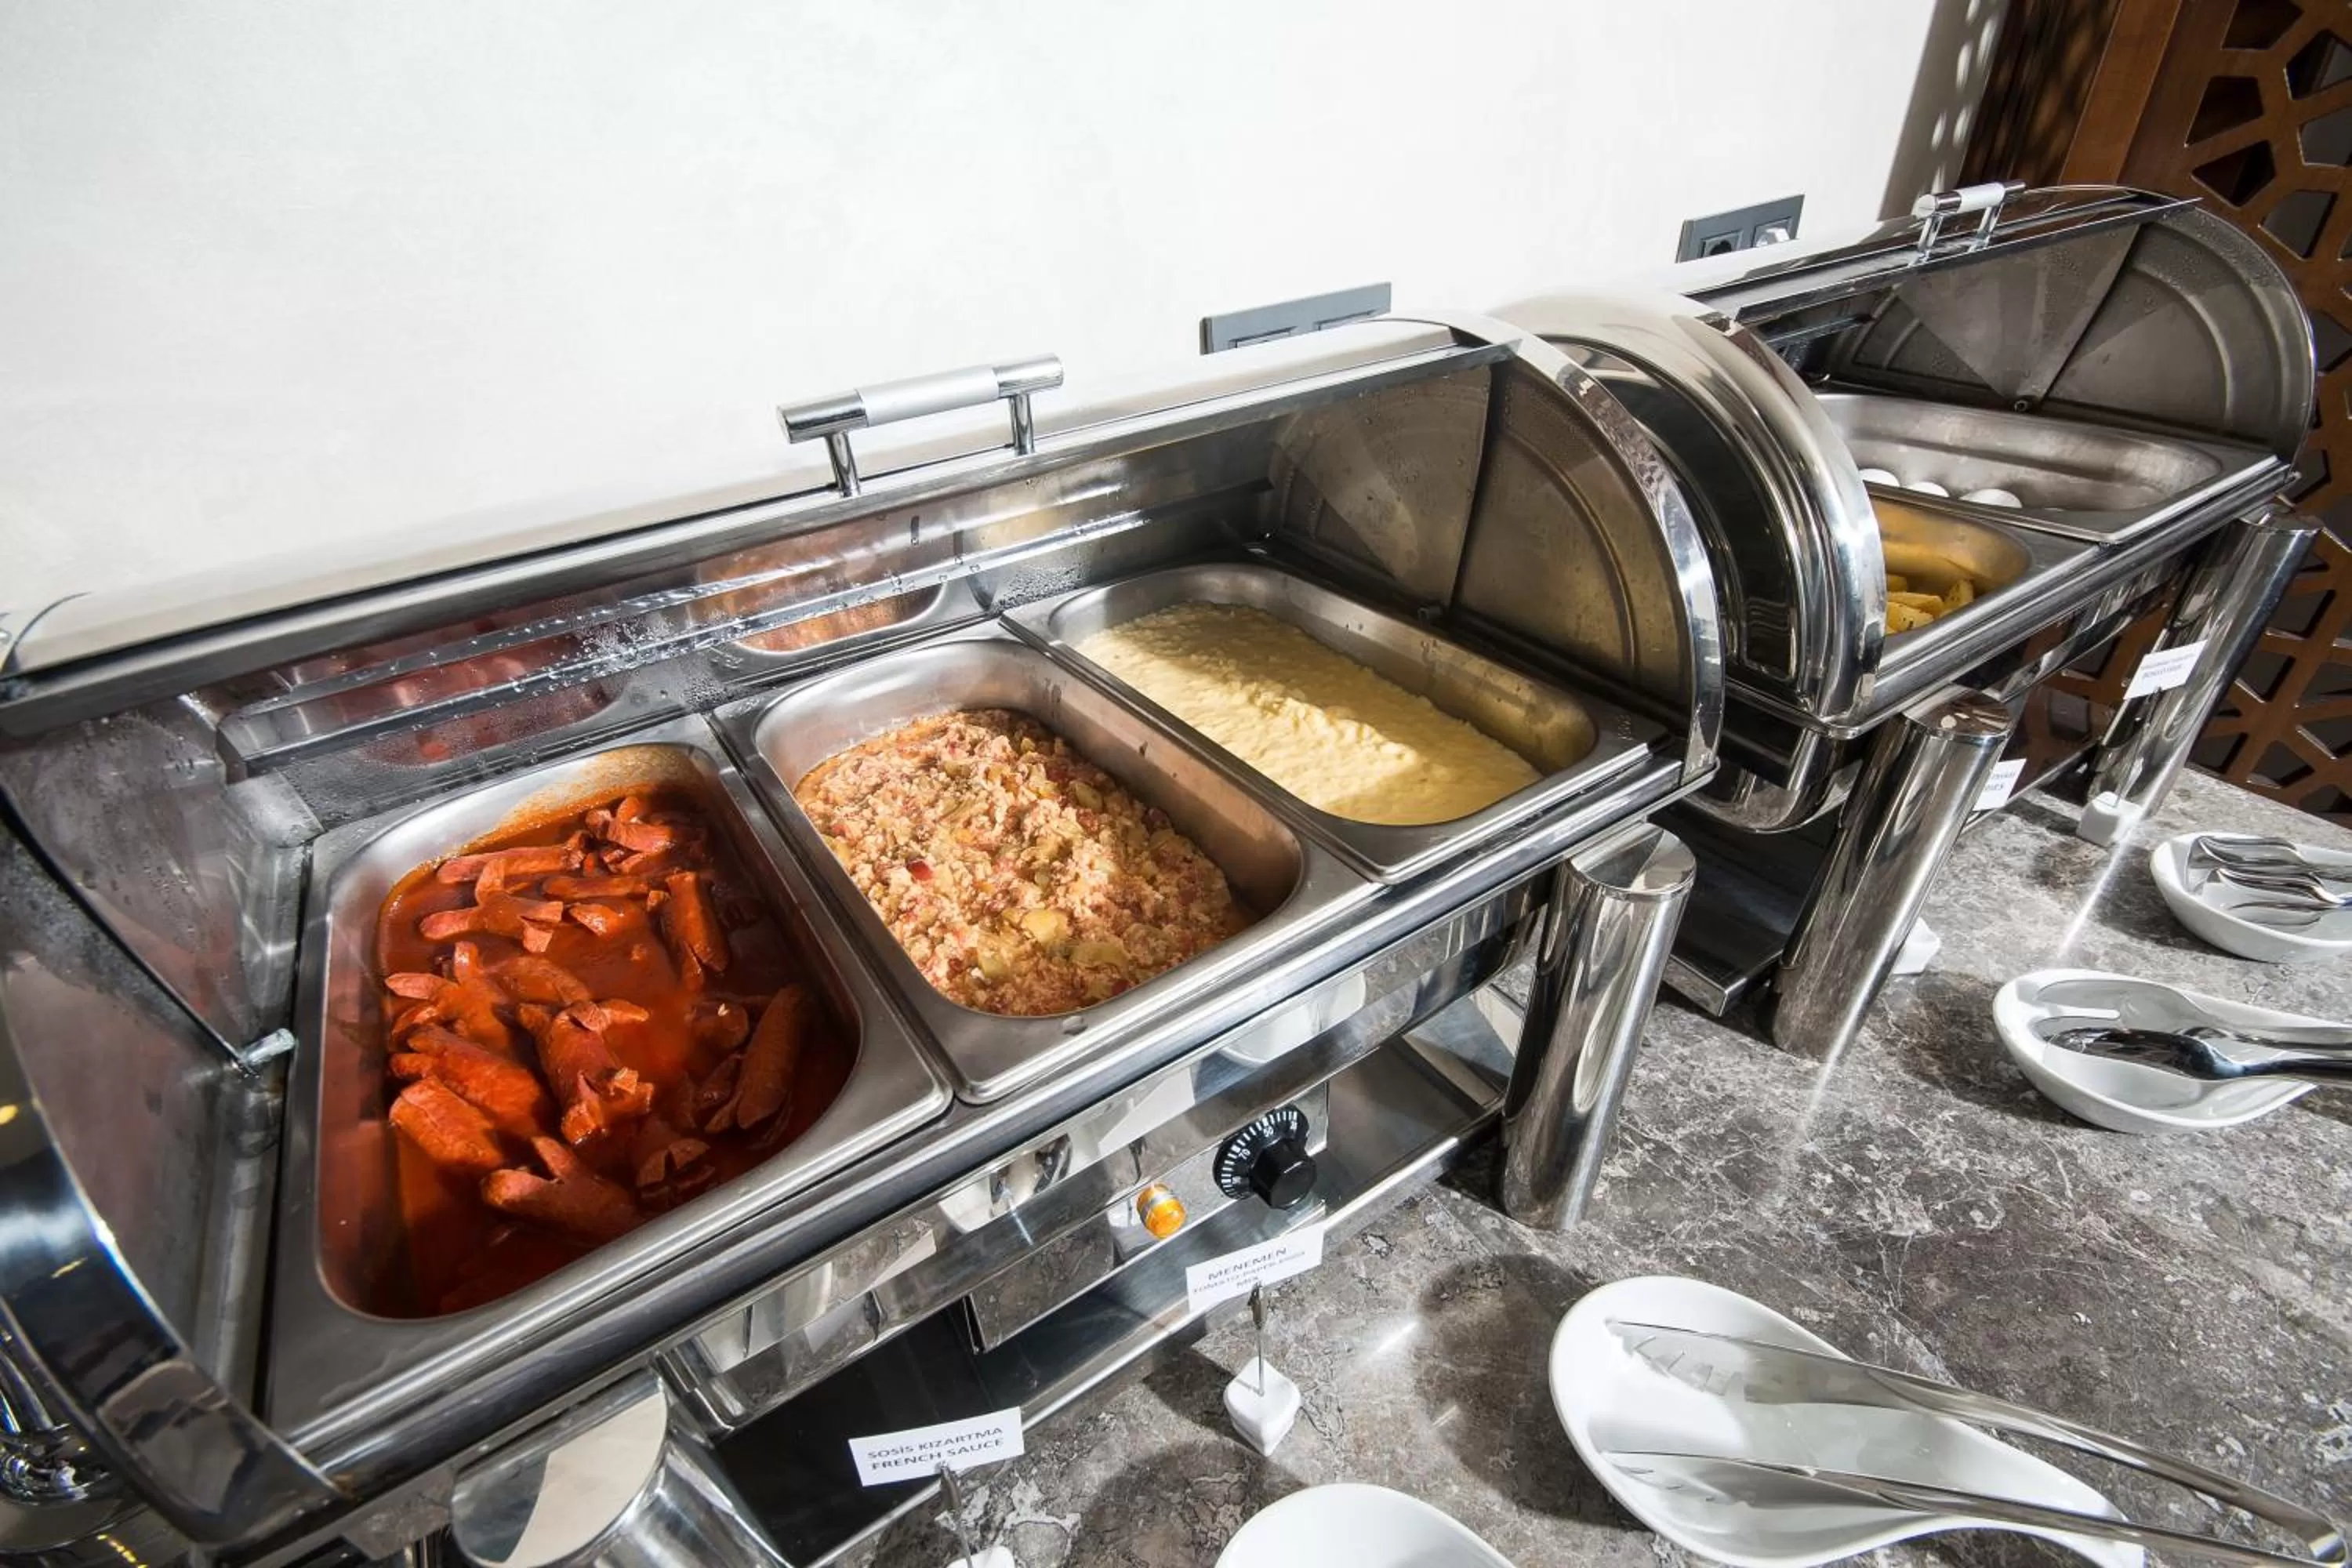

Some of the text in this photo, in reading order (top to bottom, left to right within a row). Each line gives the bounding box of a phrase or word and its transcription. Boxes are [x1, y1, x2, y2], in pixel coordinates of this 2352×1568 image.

[1263, 1126, 1274, 1138] 50
[1238, 1149, 1251, 1160] 70
[1208, 1247, 1287, 1280] MENEMEN
[918, 1427, 1004, 1450] KIZARTMA
[872, 1438, 1004, 1471] FRENCH SAUCE
